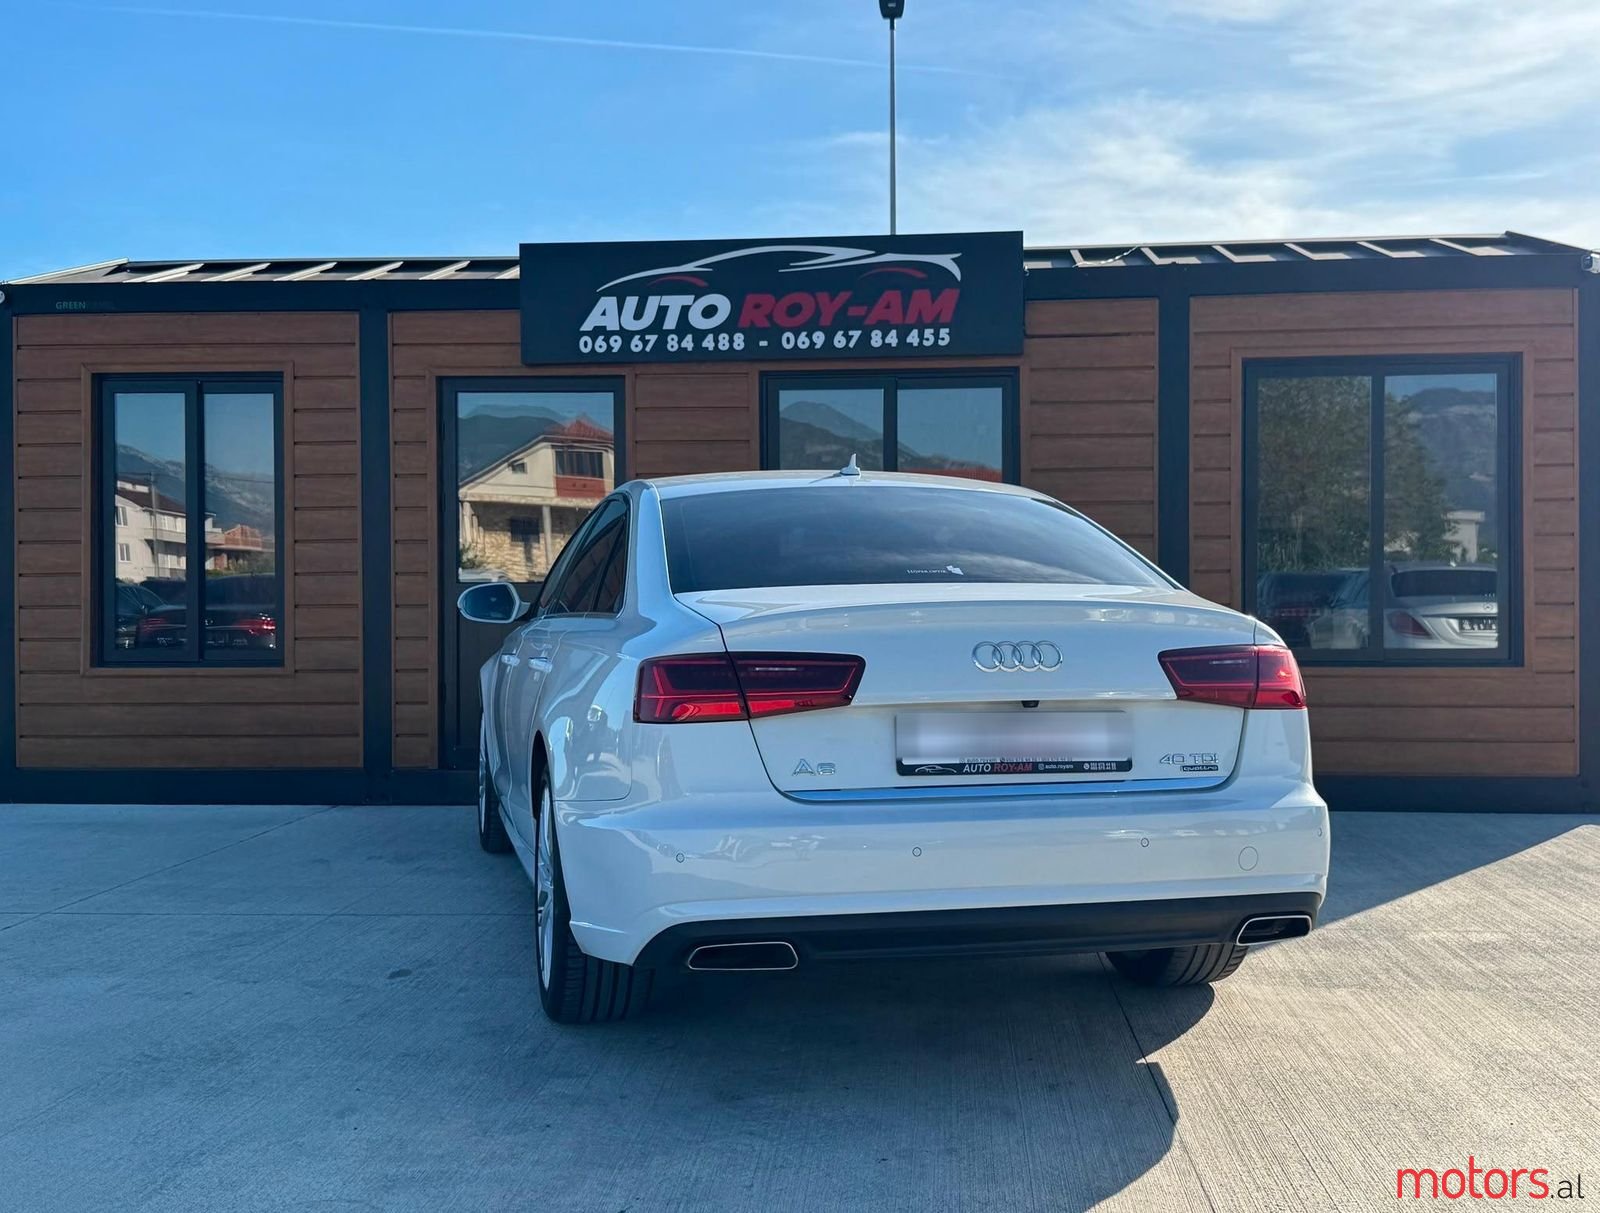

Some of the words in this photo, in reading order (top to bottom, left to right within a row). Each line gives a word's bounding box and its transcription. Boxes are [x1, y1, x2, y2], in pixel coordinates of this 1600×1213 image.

[55, 301, 86, 310] GREEN
[579, 293, 732, 332] AUTO
[737, 288, 961, 328] ROY-AM
[578, 334, 623, 353] 069
[630, 334, 659, 353] 67
[666, 333, 694, 352] 84
[701, 332, 745, 351] 488
[781, 330, 826, 349] 069
[833, 330, 862, 349] 67
[870, 329, 898, 347] 84
[906, 328, 950, 347] 455
[1159, 753, 1185, 765] 40
[1188, 753, 1219, 765] TDI
[791, 758, 836, 776] A6
[962, 763, 992, 773] AUTO
